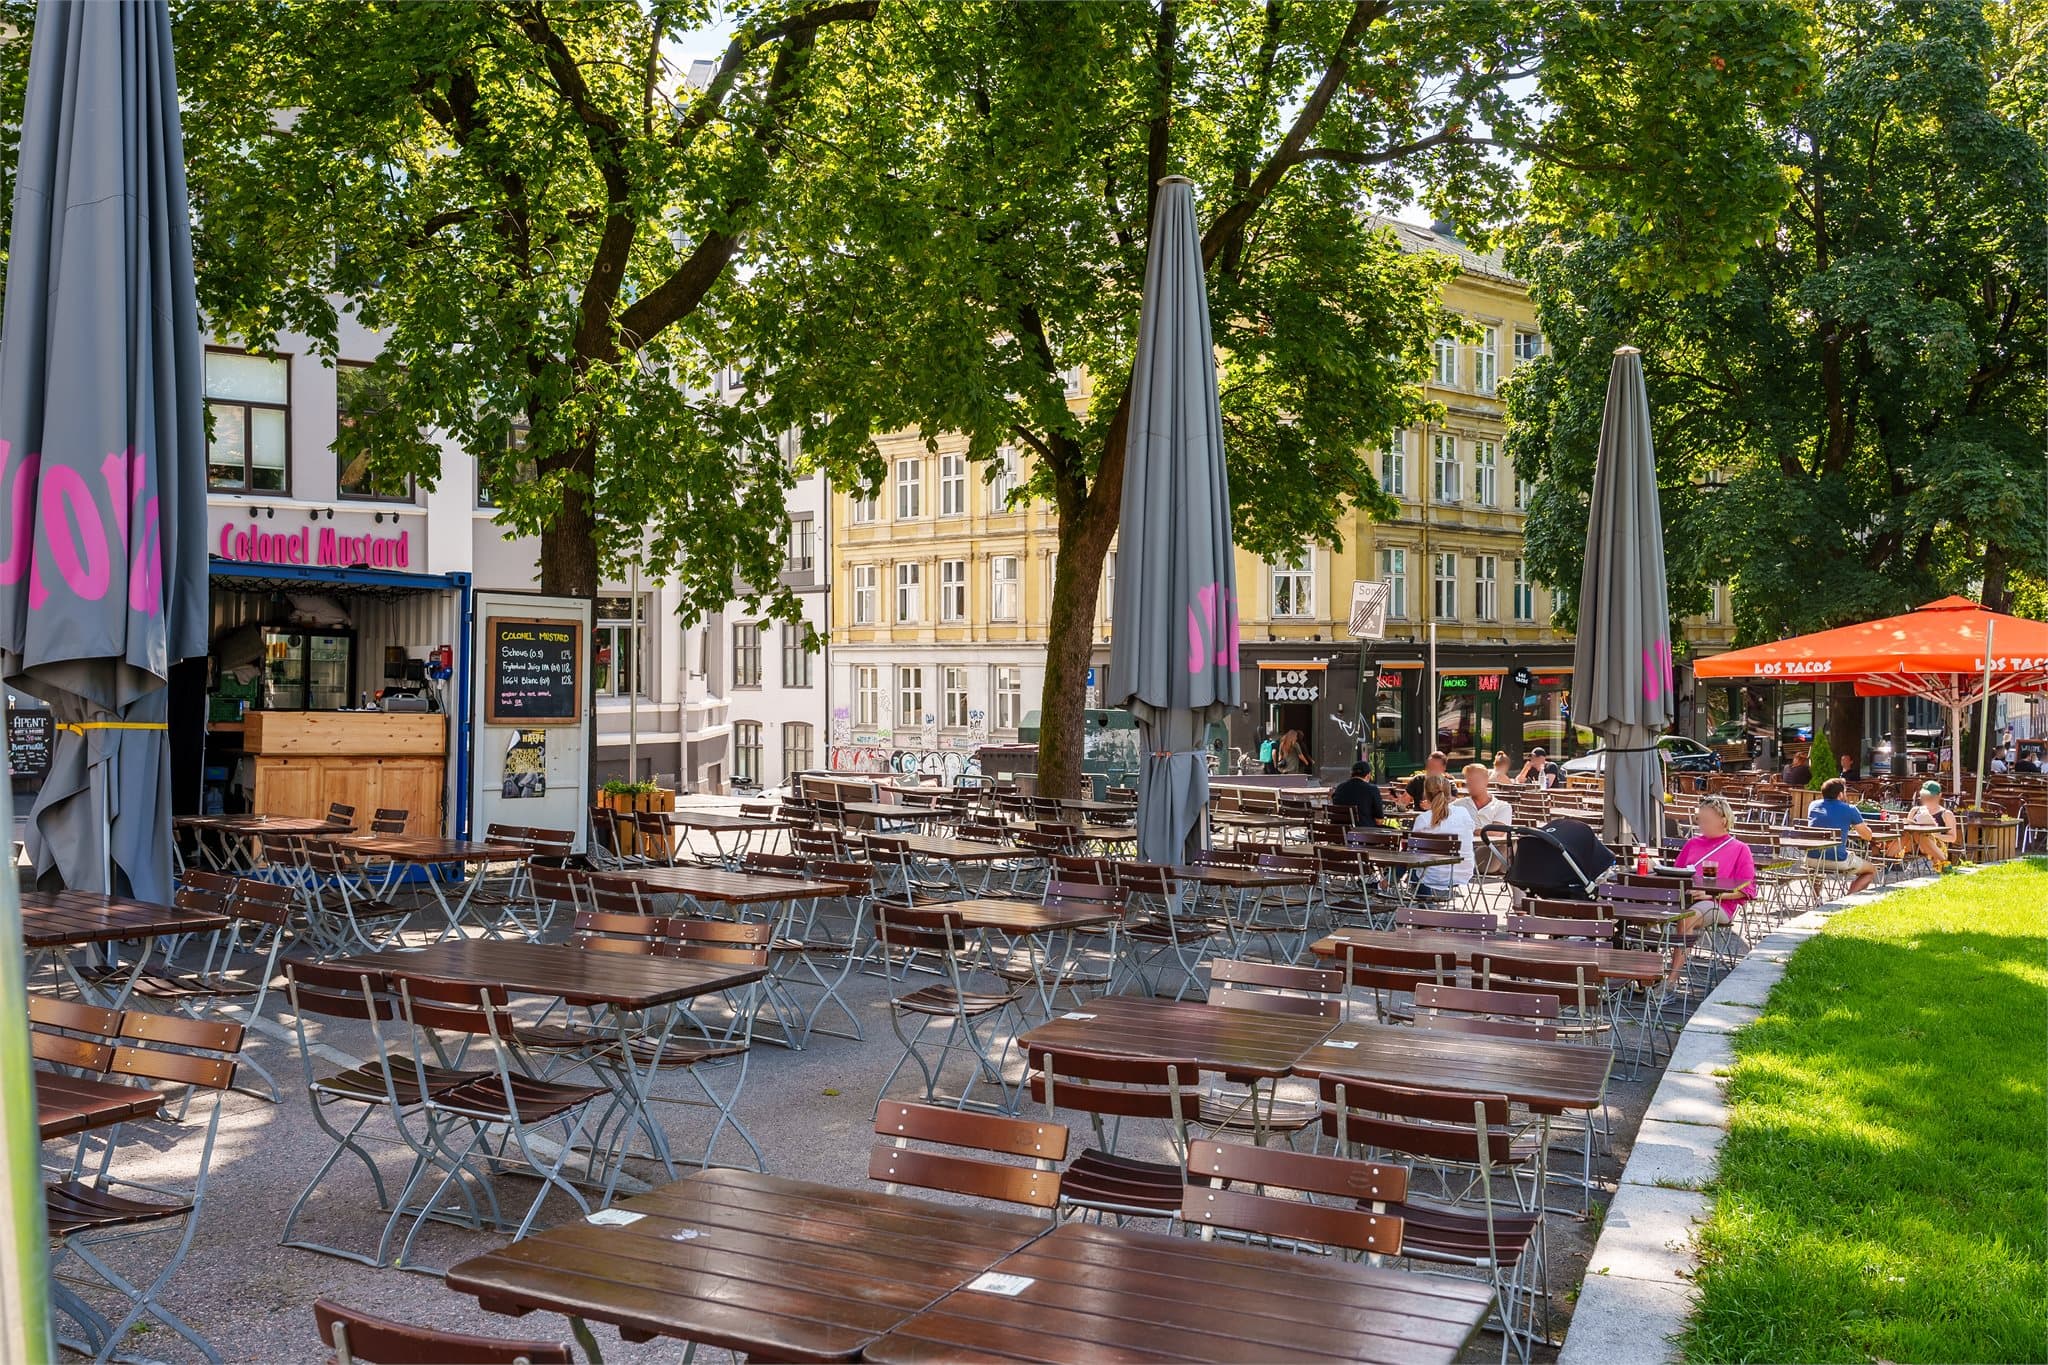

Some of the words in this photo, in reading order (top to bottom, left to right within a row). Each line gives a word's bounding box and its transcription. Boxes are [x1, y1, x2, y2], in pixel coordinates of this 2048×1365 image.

[220, 523, 309, 564] Colonel
[317, 527, 409, 568] Mustard
[539, 632, 570, 642] MUSTARD
[1754, 663, 1781, 674] LOS
[1785, 660, 1832, 673] TACOS
[521, 676, 539, 685] Blanc
[1276, 670, 1308, 685] LOS
[1443, 679, 1467, 688] NACHOS
[1265, 686, 1319, 701] TACOS
[14, 716, 47, 728] ÅPENT
